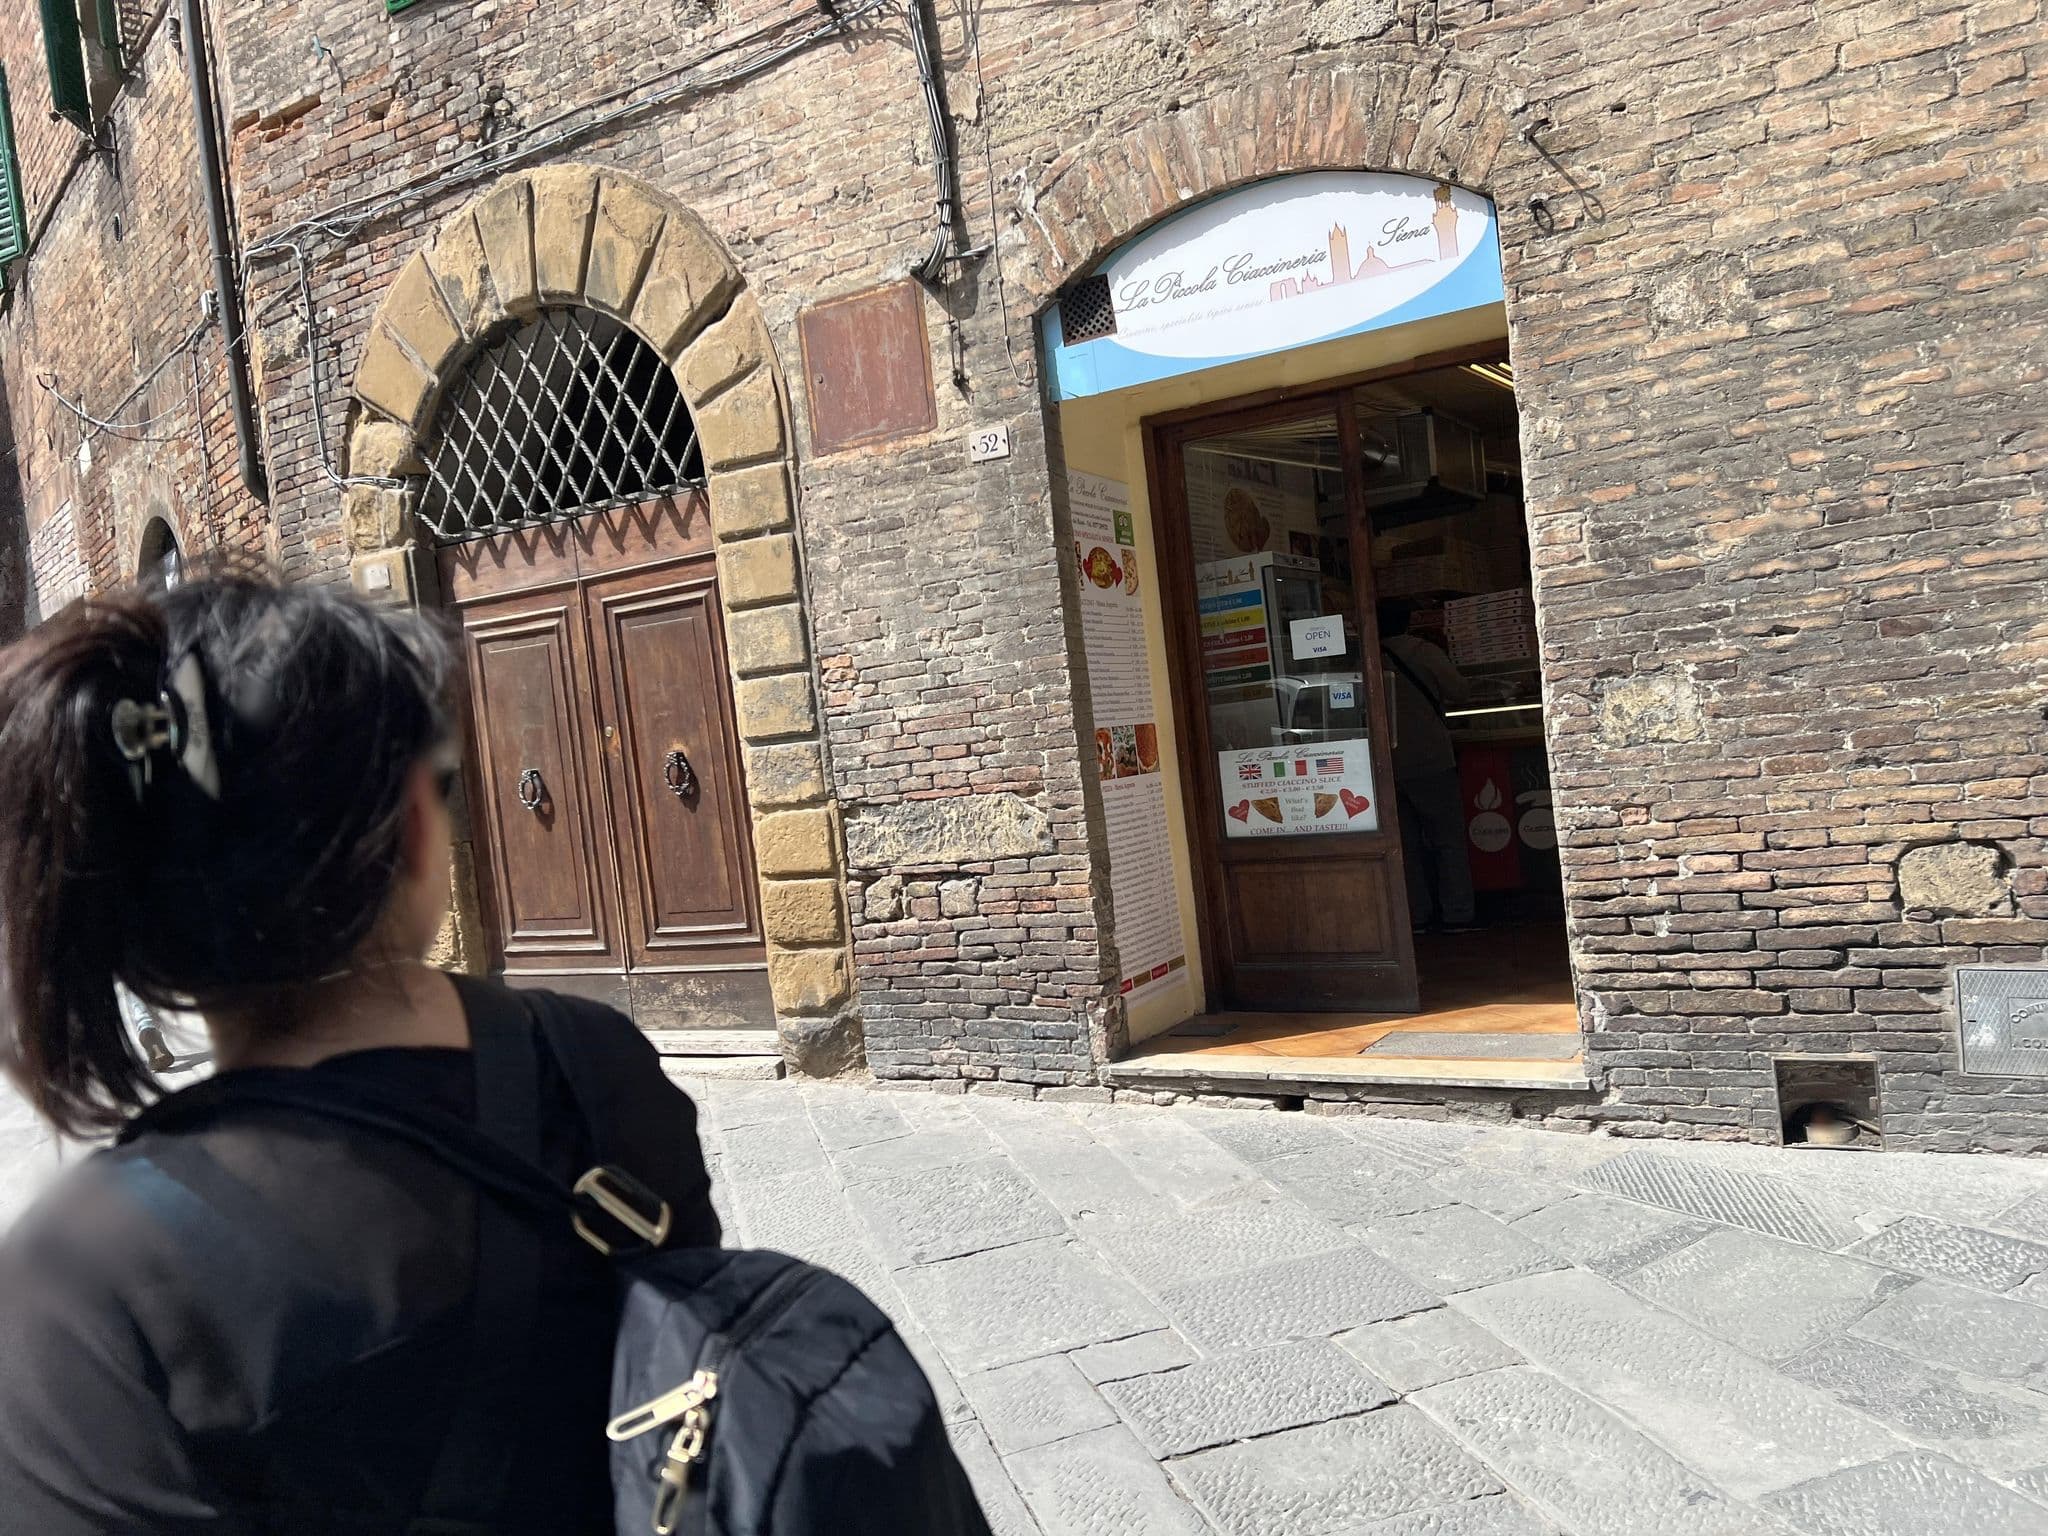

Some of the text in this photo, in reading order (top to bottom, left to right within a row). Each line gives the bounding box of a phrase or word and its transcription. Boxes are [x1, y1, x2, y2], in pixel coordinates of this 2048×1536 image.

[1377, 216, 1432, 248] Siena
[1114, 248, 1328, 314] La Piccola Ciaccineria
[979, 433, 999, 454] 52
[1305, 630, 1331, 641] OPEN
[1333, 692, 1352, 700] VISA
[1319, 776, 1342, 784] SLICE
[1250, 827, 1274, 836] COME
